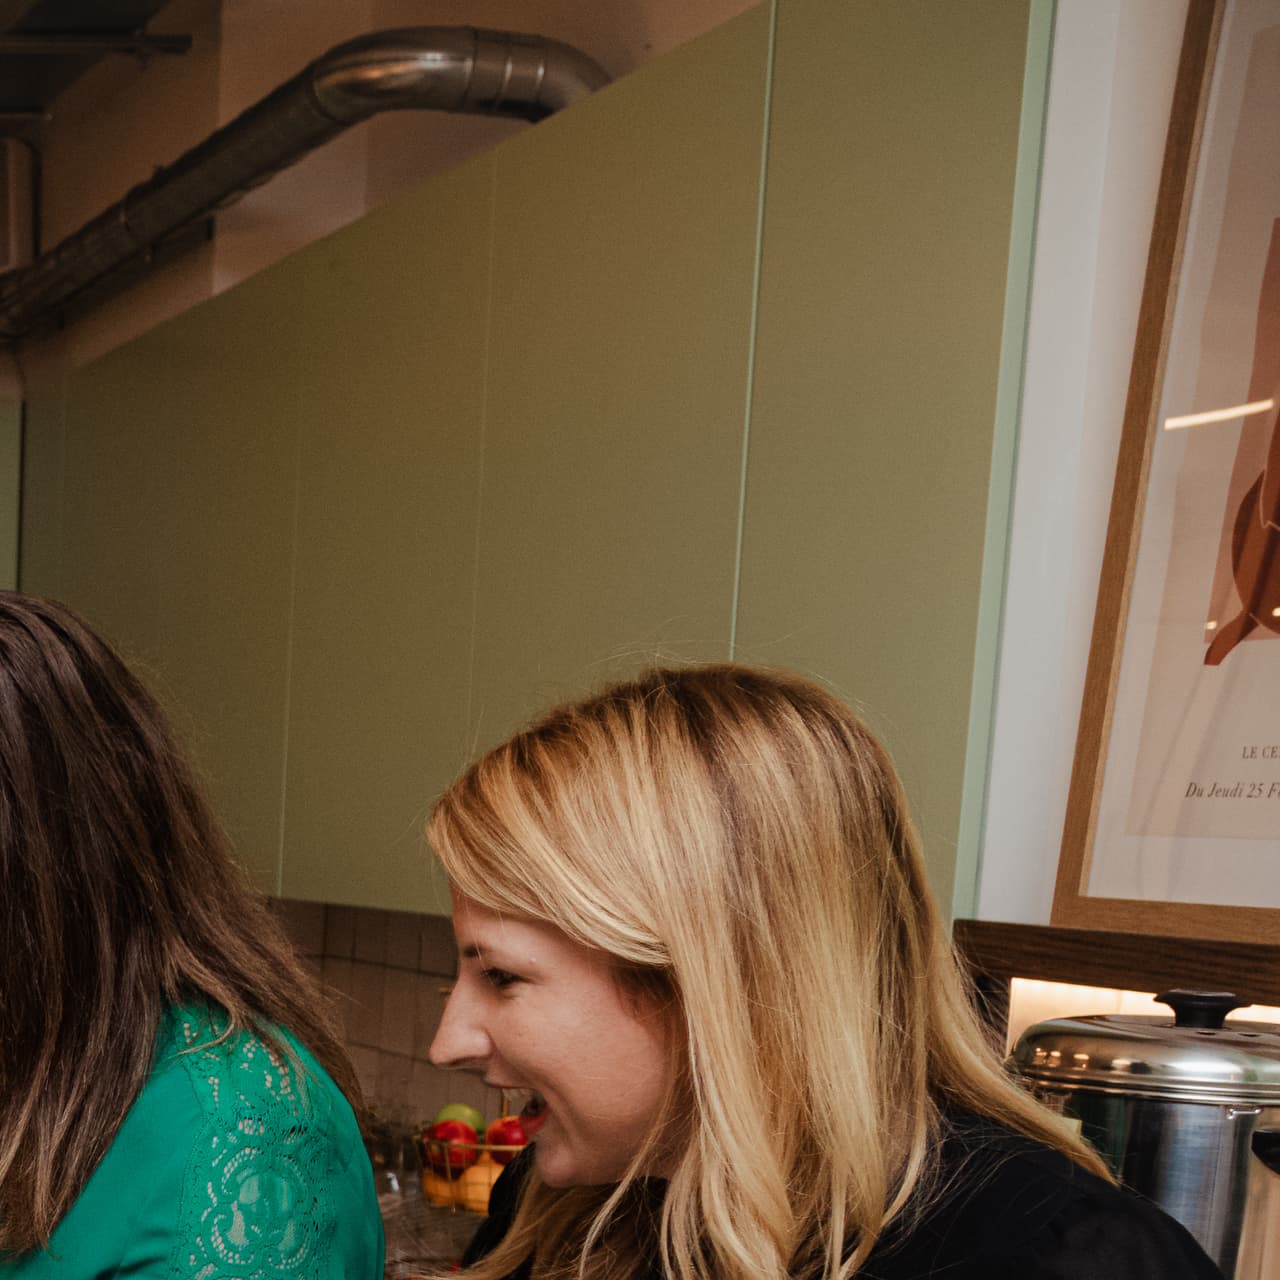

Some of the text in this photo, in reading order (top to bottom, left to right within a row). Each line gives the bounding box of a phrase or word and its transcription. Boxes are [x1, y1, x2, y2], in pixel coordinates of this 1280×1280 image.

[1242, 745, 1280, 759] LE CE
[1185, 782, 1204, 798] Du
[1207, 781, 1243, 798] Jeudi
[1246, 783, 1264, 798] 25
